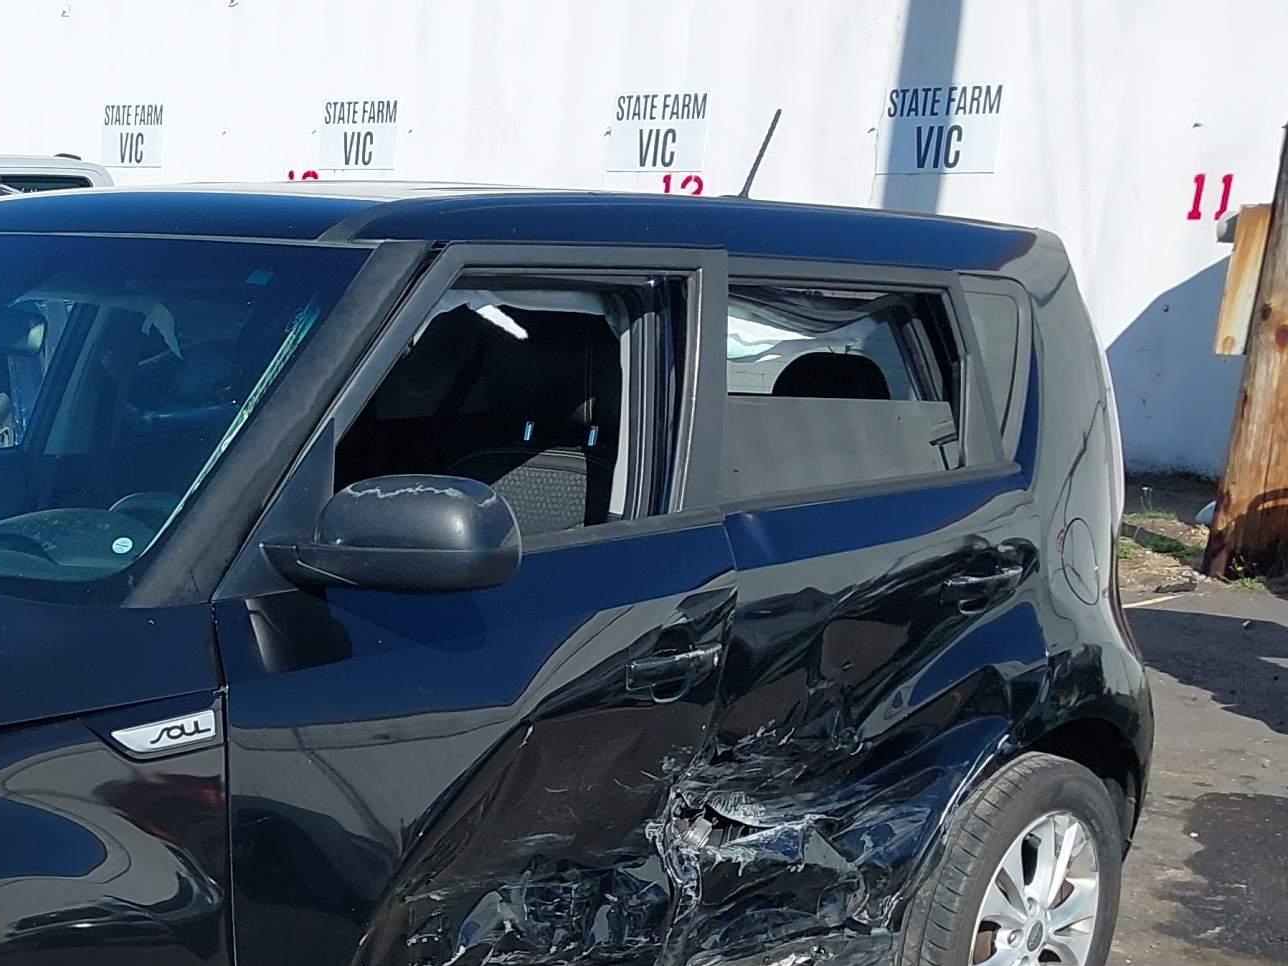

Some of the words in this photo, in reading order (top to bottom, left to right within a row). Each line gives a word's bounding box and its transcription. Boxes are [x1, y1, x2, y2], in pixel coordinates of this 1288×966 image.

[104, 104, 132, 126] STATE
[134, 103, 164, 126] FARM
[324, 101, 359, 125] STATE
[361, 99, 398, 124] FARM
[616, 94, 659, 121] STATE
[661, 93, 708, 120] FARM
[887, 87, 942, 118] STATE
[945, 84, 1003, 116] FARM
[120, 131, 145, 164] VIC
[343, 130, 374, 166] VIC
[639, 128, 677, 168] VIC
[915, 124, 963, 169] VIC
[1186, 173, 1234, 221] 11
